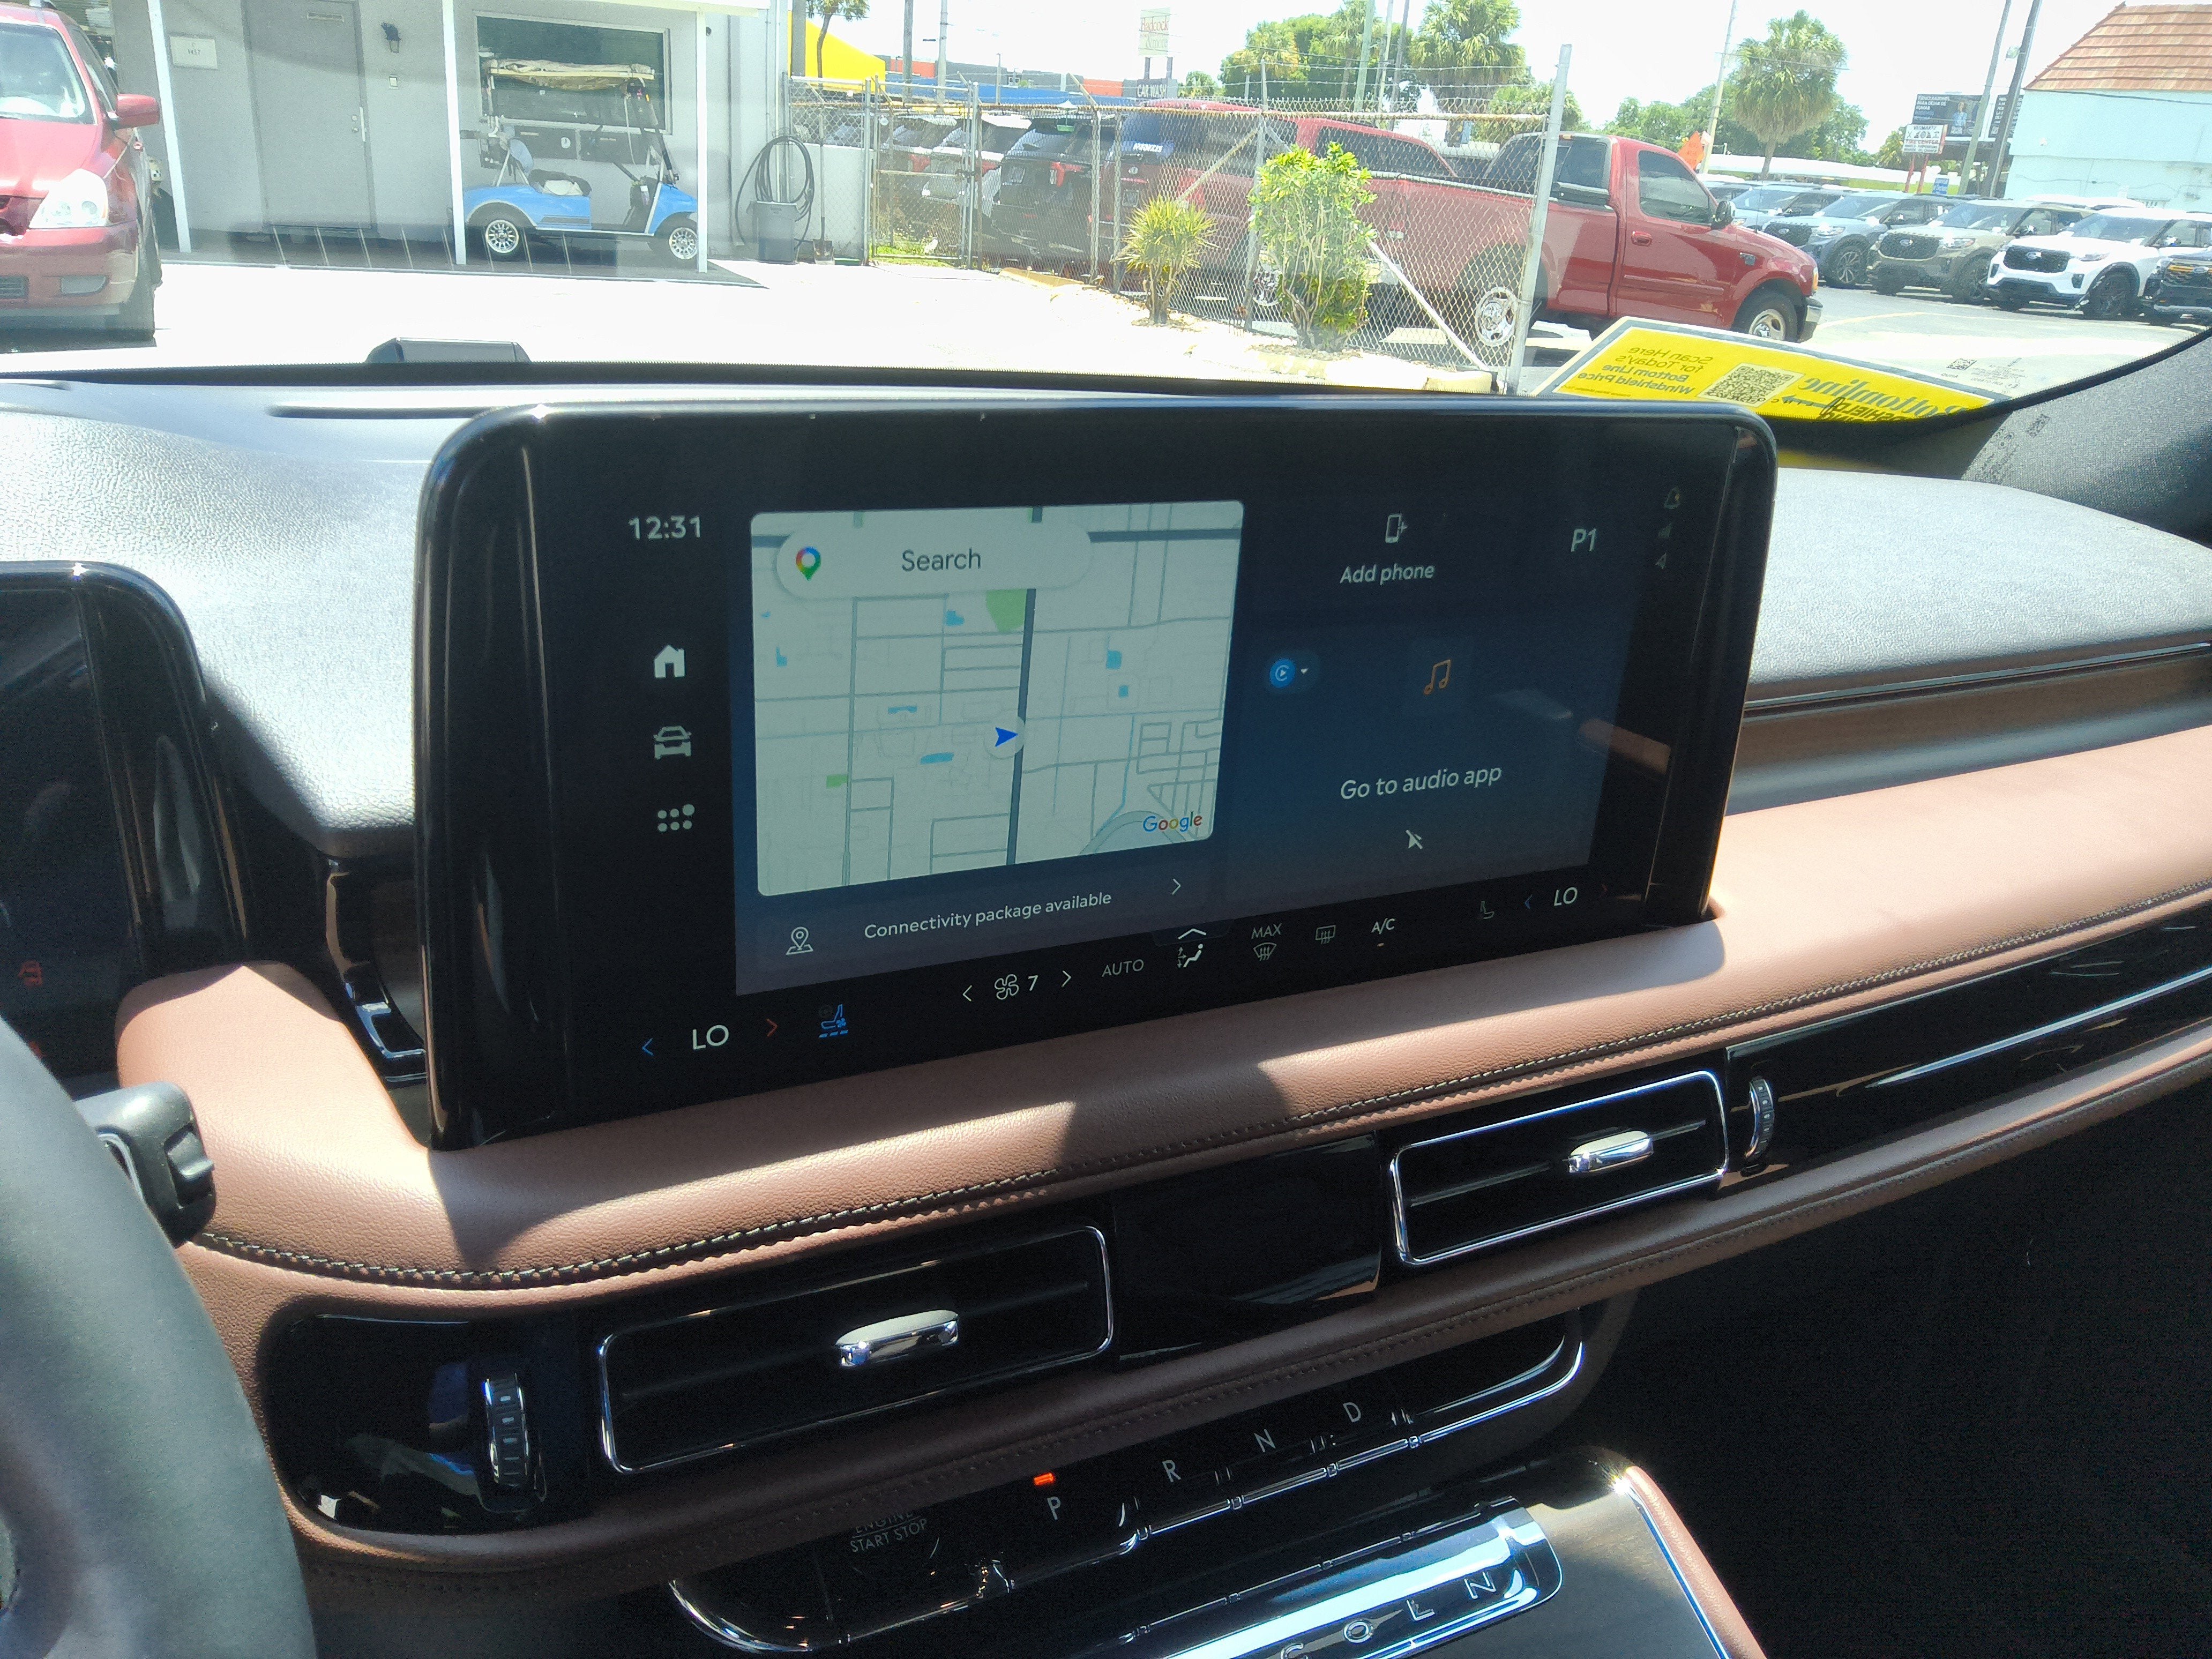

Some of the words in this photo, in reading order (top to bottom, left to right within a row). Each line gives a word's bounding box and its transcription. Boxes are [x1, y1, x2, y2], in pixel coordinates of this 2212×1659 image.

[1137, 84, 1148, 98] CAR
[1150, 84, 1167, 99] WASH
[629, 515, 702, 540] 12:31
[1570, 527, 1597, 553] P1
[901, 547, 981, 572] Search
[1339, 564, 1377, 586] Add
[1379, 563, 1436, 586] phone
[1340, 779, 1370, 801] Go
[1376, 776, 1398, 796] to
[1402, 767, 1459, 793] audio
[1463, 766, 1502, 789] app
[1142, 811, 1203, 833] Google
[1553, 886, 1579, 907] LO
[864, 913, 972, 939] Connectivity
[975, 904, 1042, 926] package
[1045, 892, 1112, 913] available
[1371, 917, 1396, 935] A/C
[1251, 923, 1282, 941] MAX
[1101, 959, 1145, 978] AUTO
[1027, 975, 1038, 992] 7
[691, 1024, 730, 1051] LO
[1047, 1496, 1061, 1521] P
[1162, 1459, 1182, 1484] R
[1253, 1428, 1275, 1453] N
[1342, 1400, 1363, 1424] D
[850, 1531, 890, 1553] START
[894, 1518, 928, 1541] STOP
